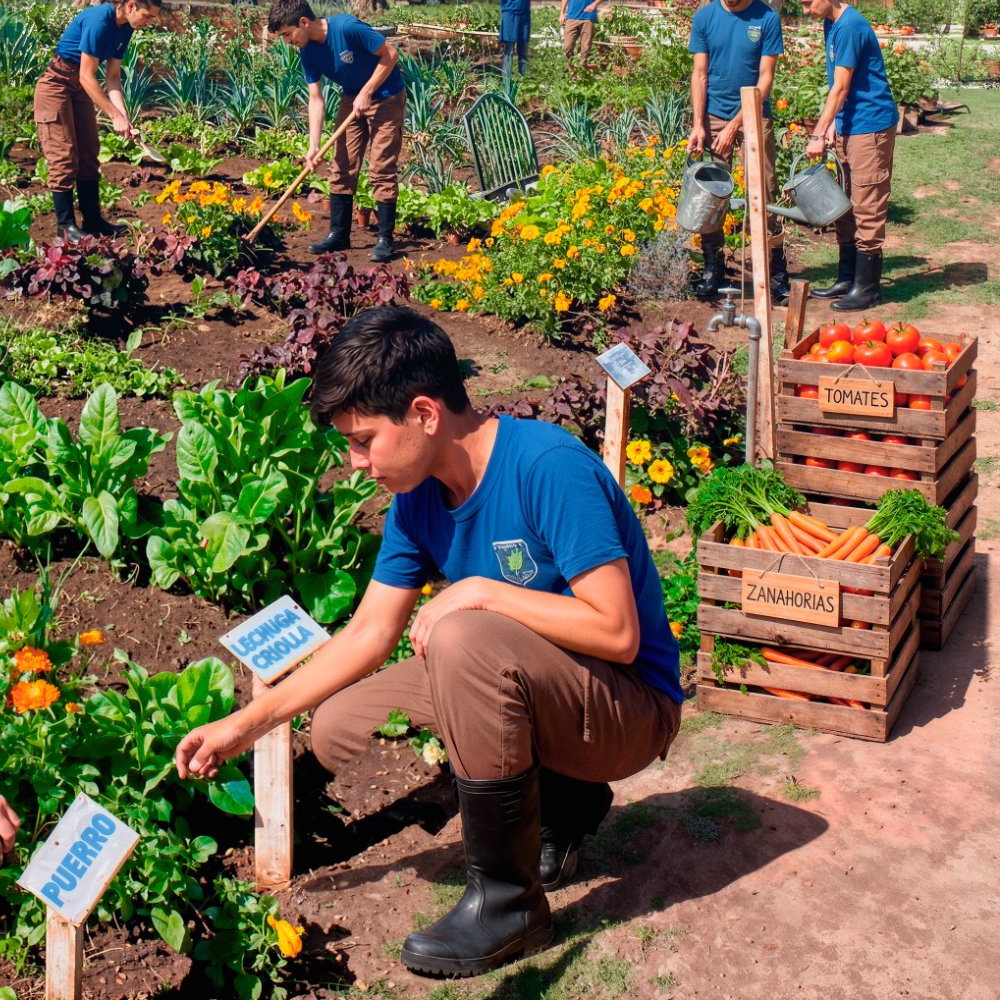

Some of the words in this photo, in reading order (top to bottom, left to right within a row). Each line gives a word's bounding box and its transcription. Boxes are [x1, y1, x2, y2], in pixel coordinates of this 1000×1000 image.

[824, 387, 889, 408] TOMATES
[746, 583, 835, 613] ZANAHORIAS
[40, 813, 117, 908] PUERRO
